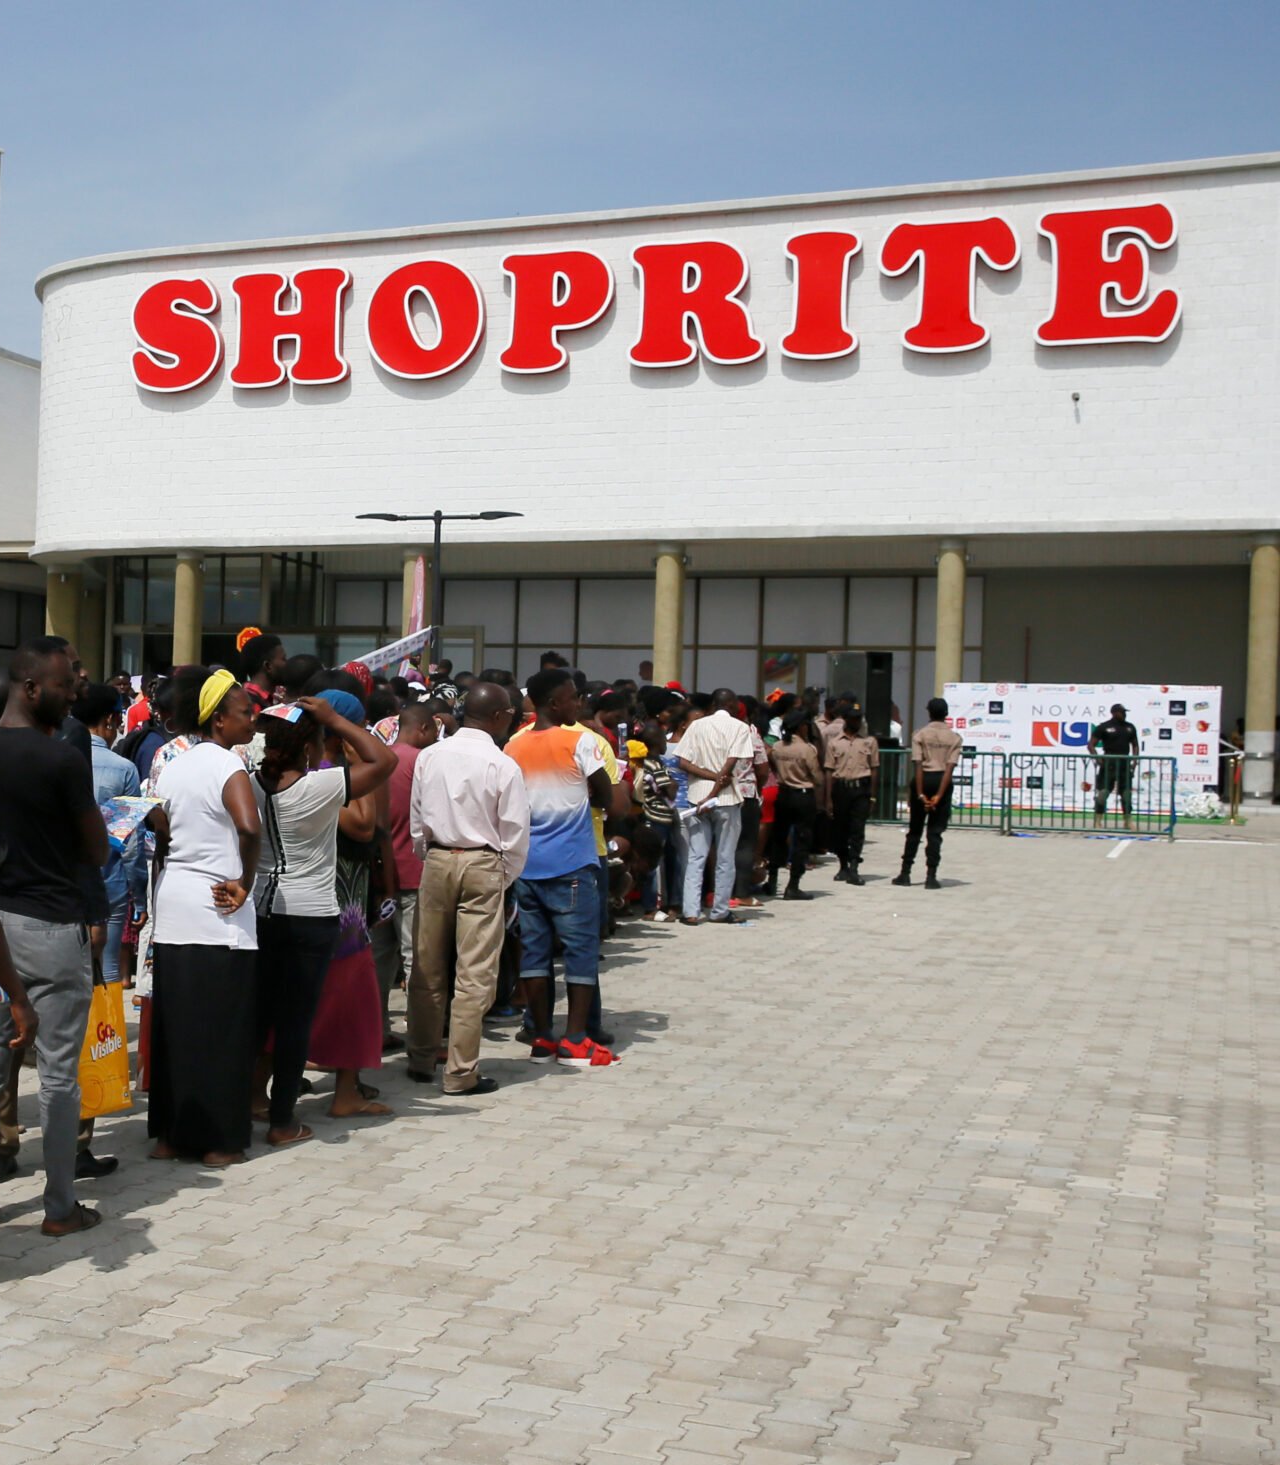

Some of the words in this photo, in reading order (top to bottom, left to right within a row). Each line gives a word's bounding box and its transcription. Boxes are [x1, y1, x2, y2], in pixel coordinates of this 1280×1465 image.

[131, 202, 1183, 394] SHOPRITE
[1031, 704, 1108, 717] NOVAR
[1013, 754, 1099, 771] GATEW
[90, 1035, 122, 1062] Visible
